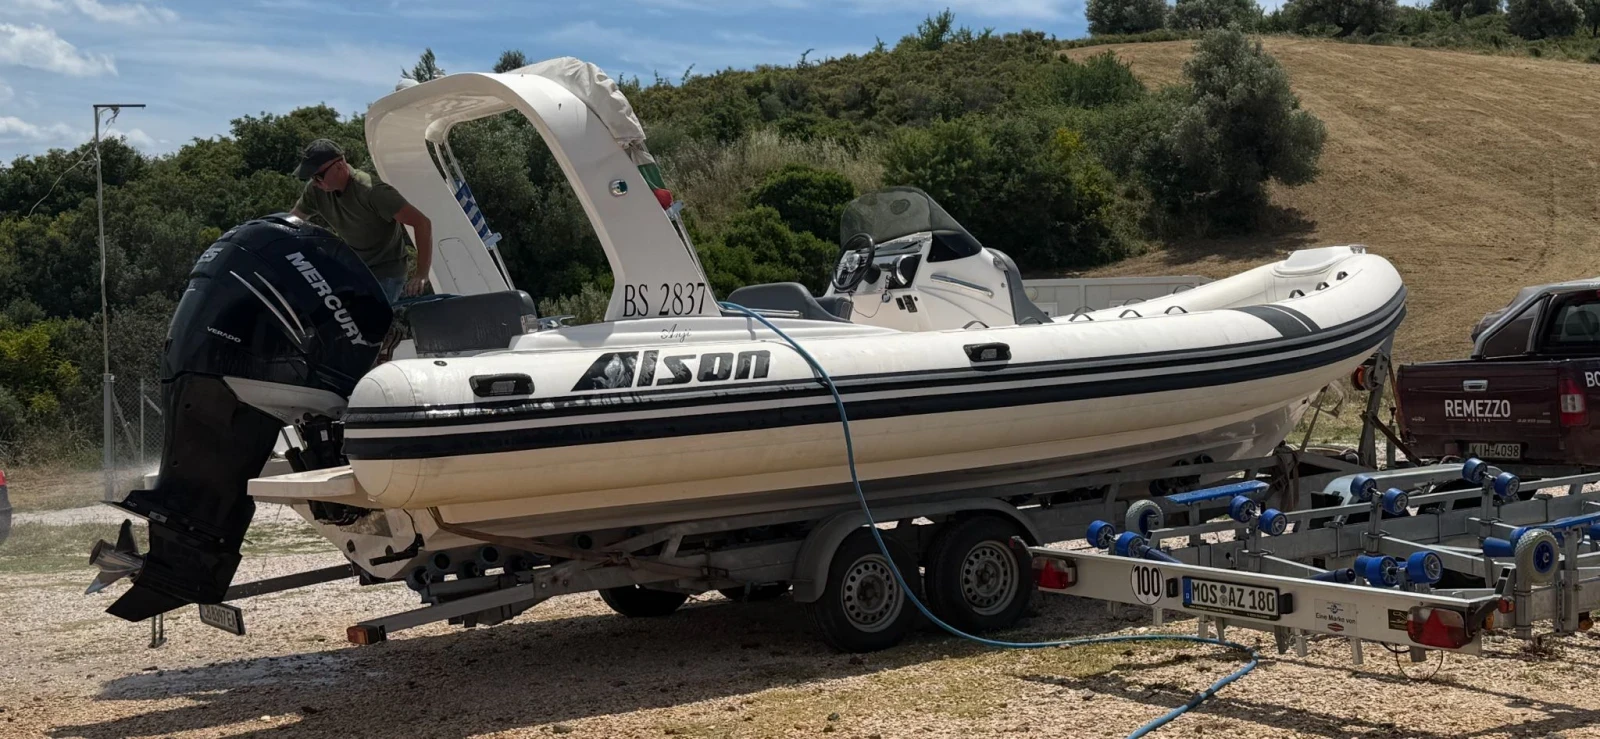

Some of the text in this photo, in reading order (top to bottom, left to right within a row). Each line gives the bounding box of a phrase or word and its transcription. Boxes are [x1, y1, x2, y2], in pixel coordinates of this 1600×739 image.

[285, 251, 368, 345] MERCURY
[623, 282, 706, 317] BS 2837
[207, 326, 241, 343] VERADO
[1444, 399, 1511, 418] REMEZZO
[1134, 566, 1161, 597] 100
[1191, 581, 1218, 604] MOS
[1228, 586, 1246, 609] AZ
[1248, 589, 1276, 613] 180
